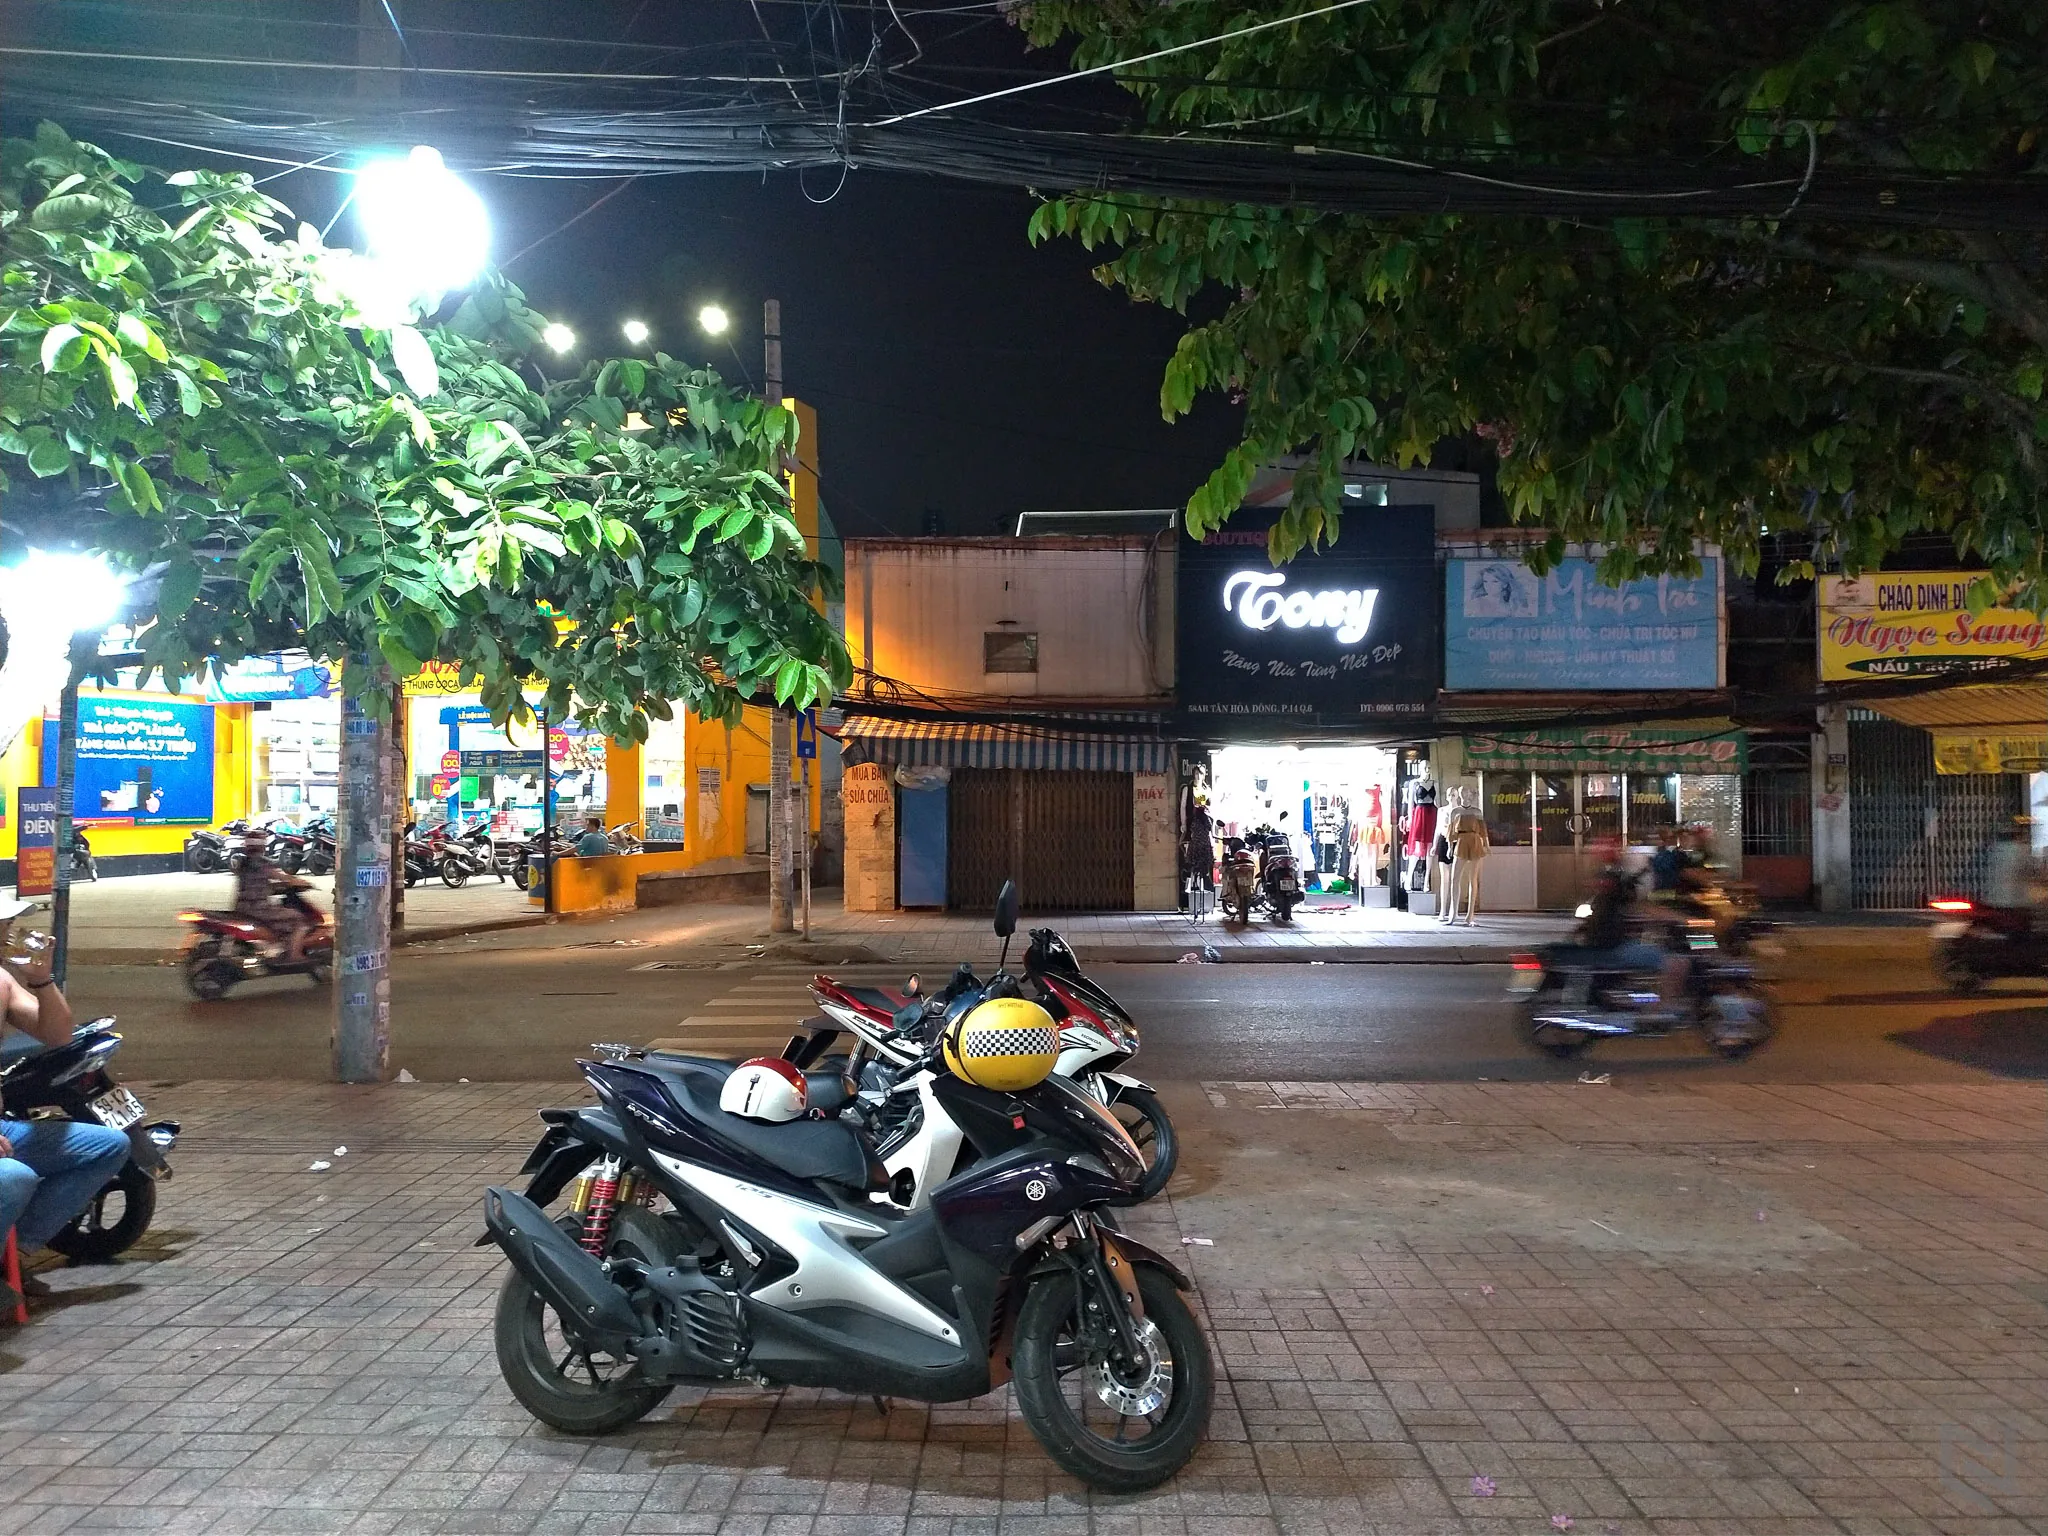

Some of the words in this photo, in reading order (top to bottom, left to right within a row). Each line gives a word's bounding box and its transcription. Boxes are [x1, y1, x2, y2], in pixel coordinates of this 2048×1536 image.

[1878, 577, 1912, 611] CHÁO
[1918, 583, 1948, 610] DINH
[1223, 571, 1379, 644] Tony
[1827, 615, 1937, 655] Ngọc
[1946, 613, 2047, 649] Sang
[1340, 654, 1368, 670] Nét
[1869, 658, 1909, 673] NẤU
[849, 784, 865, 804] SỬA
[867, 786, 889, 804] CHỮA
[1137, 785, 1165, 800] MÁY
[1490, 793, 1527, 805] TRANG
[1632, 793, 1667, 805] TRANG
[23, 816, 55, 838] ĐIỆN
[1080, 1033, 1102, 1046] HONDA
